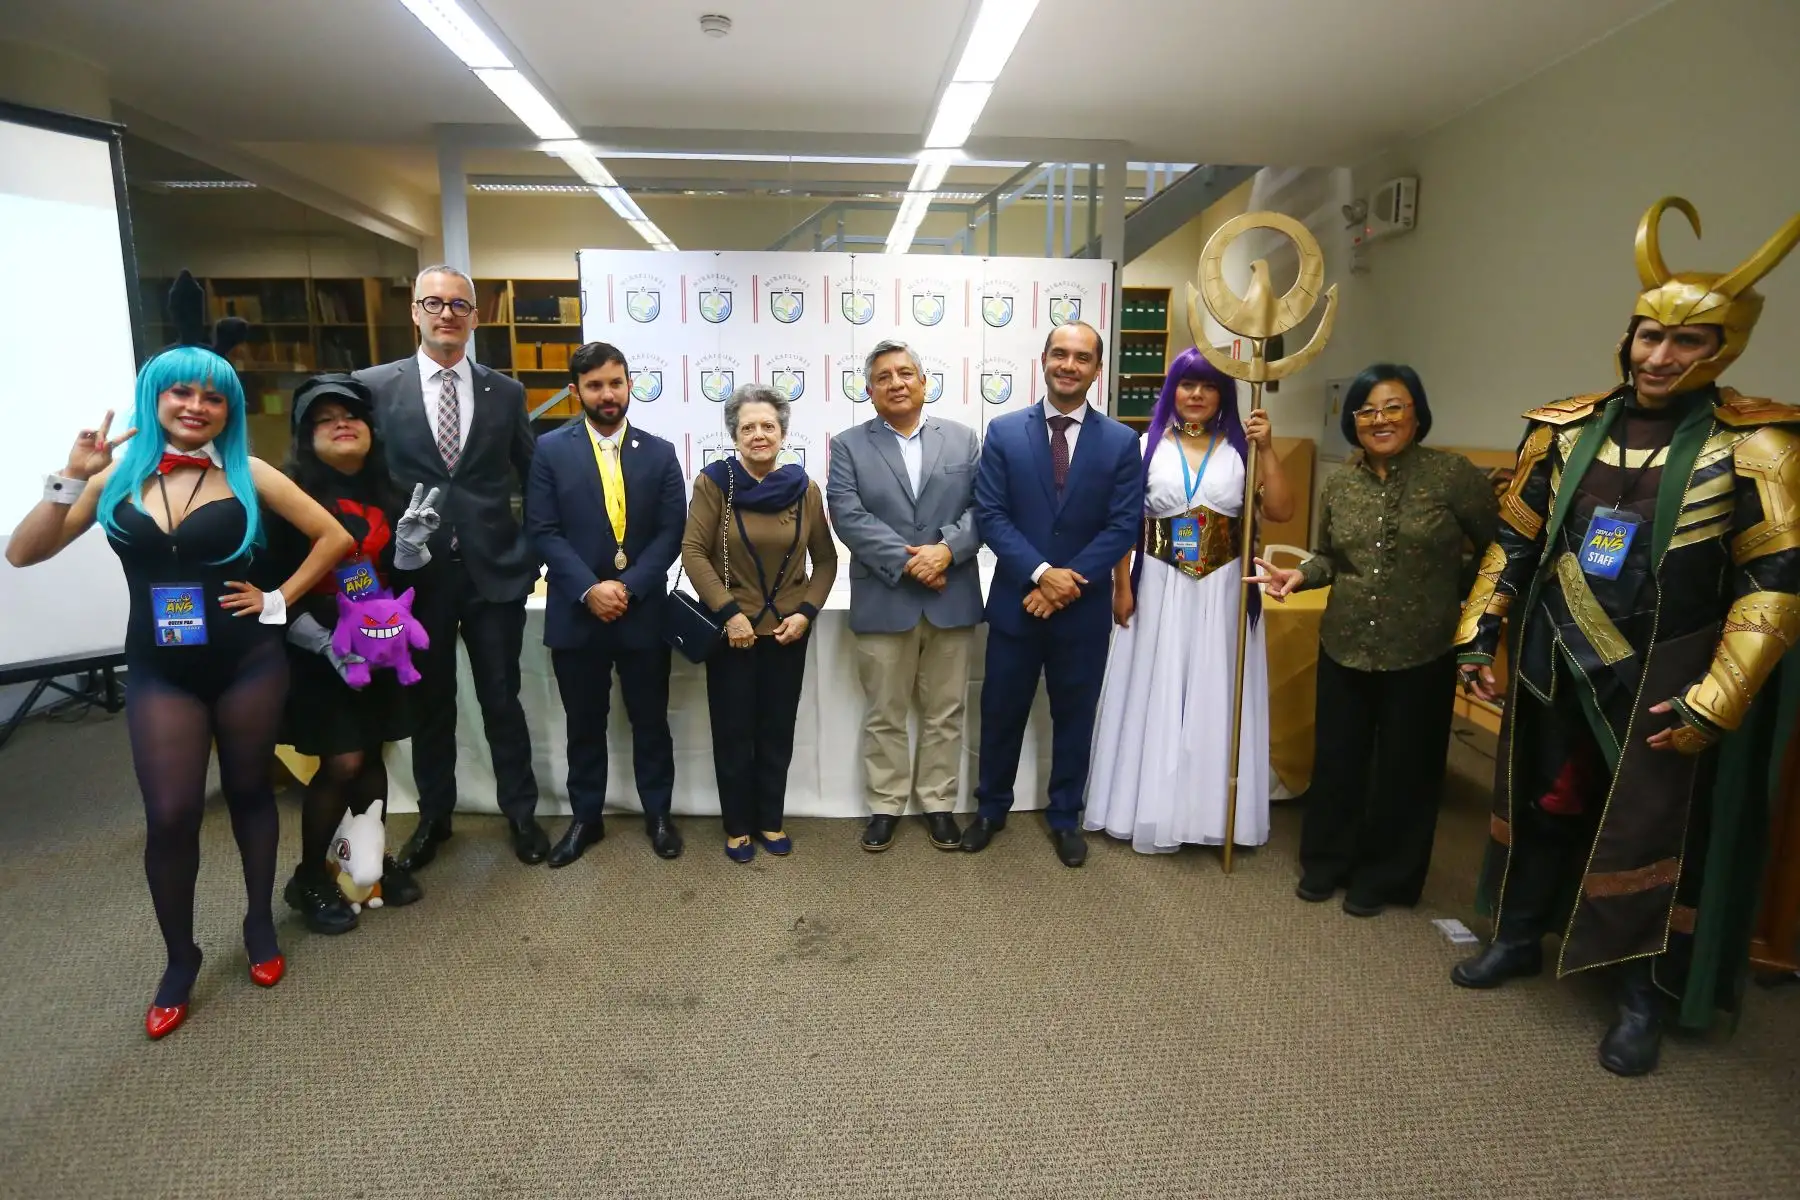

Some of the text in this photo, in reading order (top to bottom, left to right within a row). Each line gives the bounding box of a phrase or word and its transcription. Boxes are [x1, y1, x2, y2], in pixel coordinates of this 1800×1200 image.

[692, 273, 738, 288] MIRAFLORES
[763, 273, 810, 288] MIRAFLORES
[1043, 280, 1089, 295] MIRAFLORES
[627, 352, 669, 367] IRAFLORES
[694, 352, 740, 368] MIRAFLORES
[765, 353, 811, 368] MIRAFLORES
[974, 355, 1019, 371] MIRAFLORES
[1588, 551, 1614, 567] STAFF
